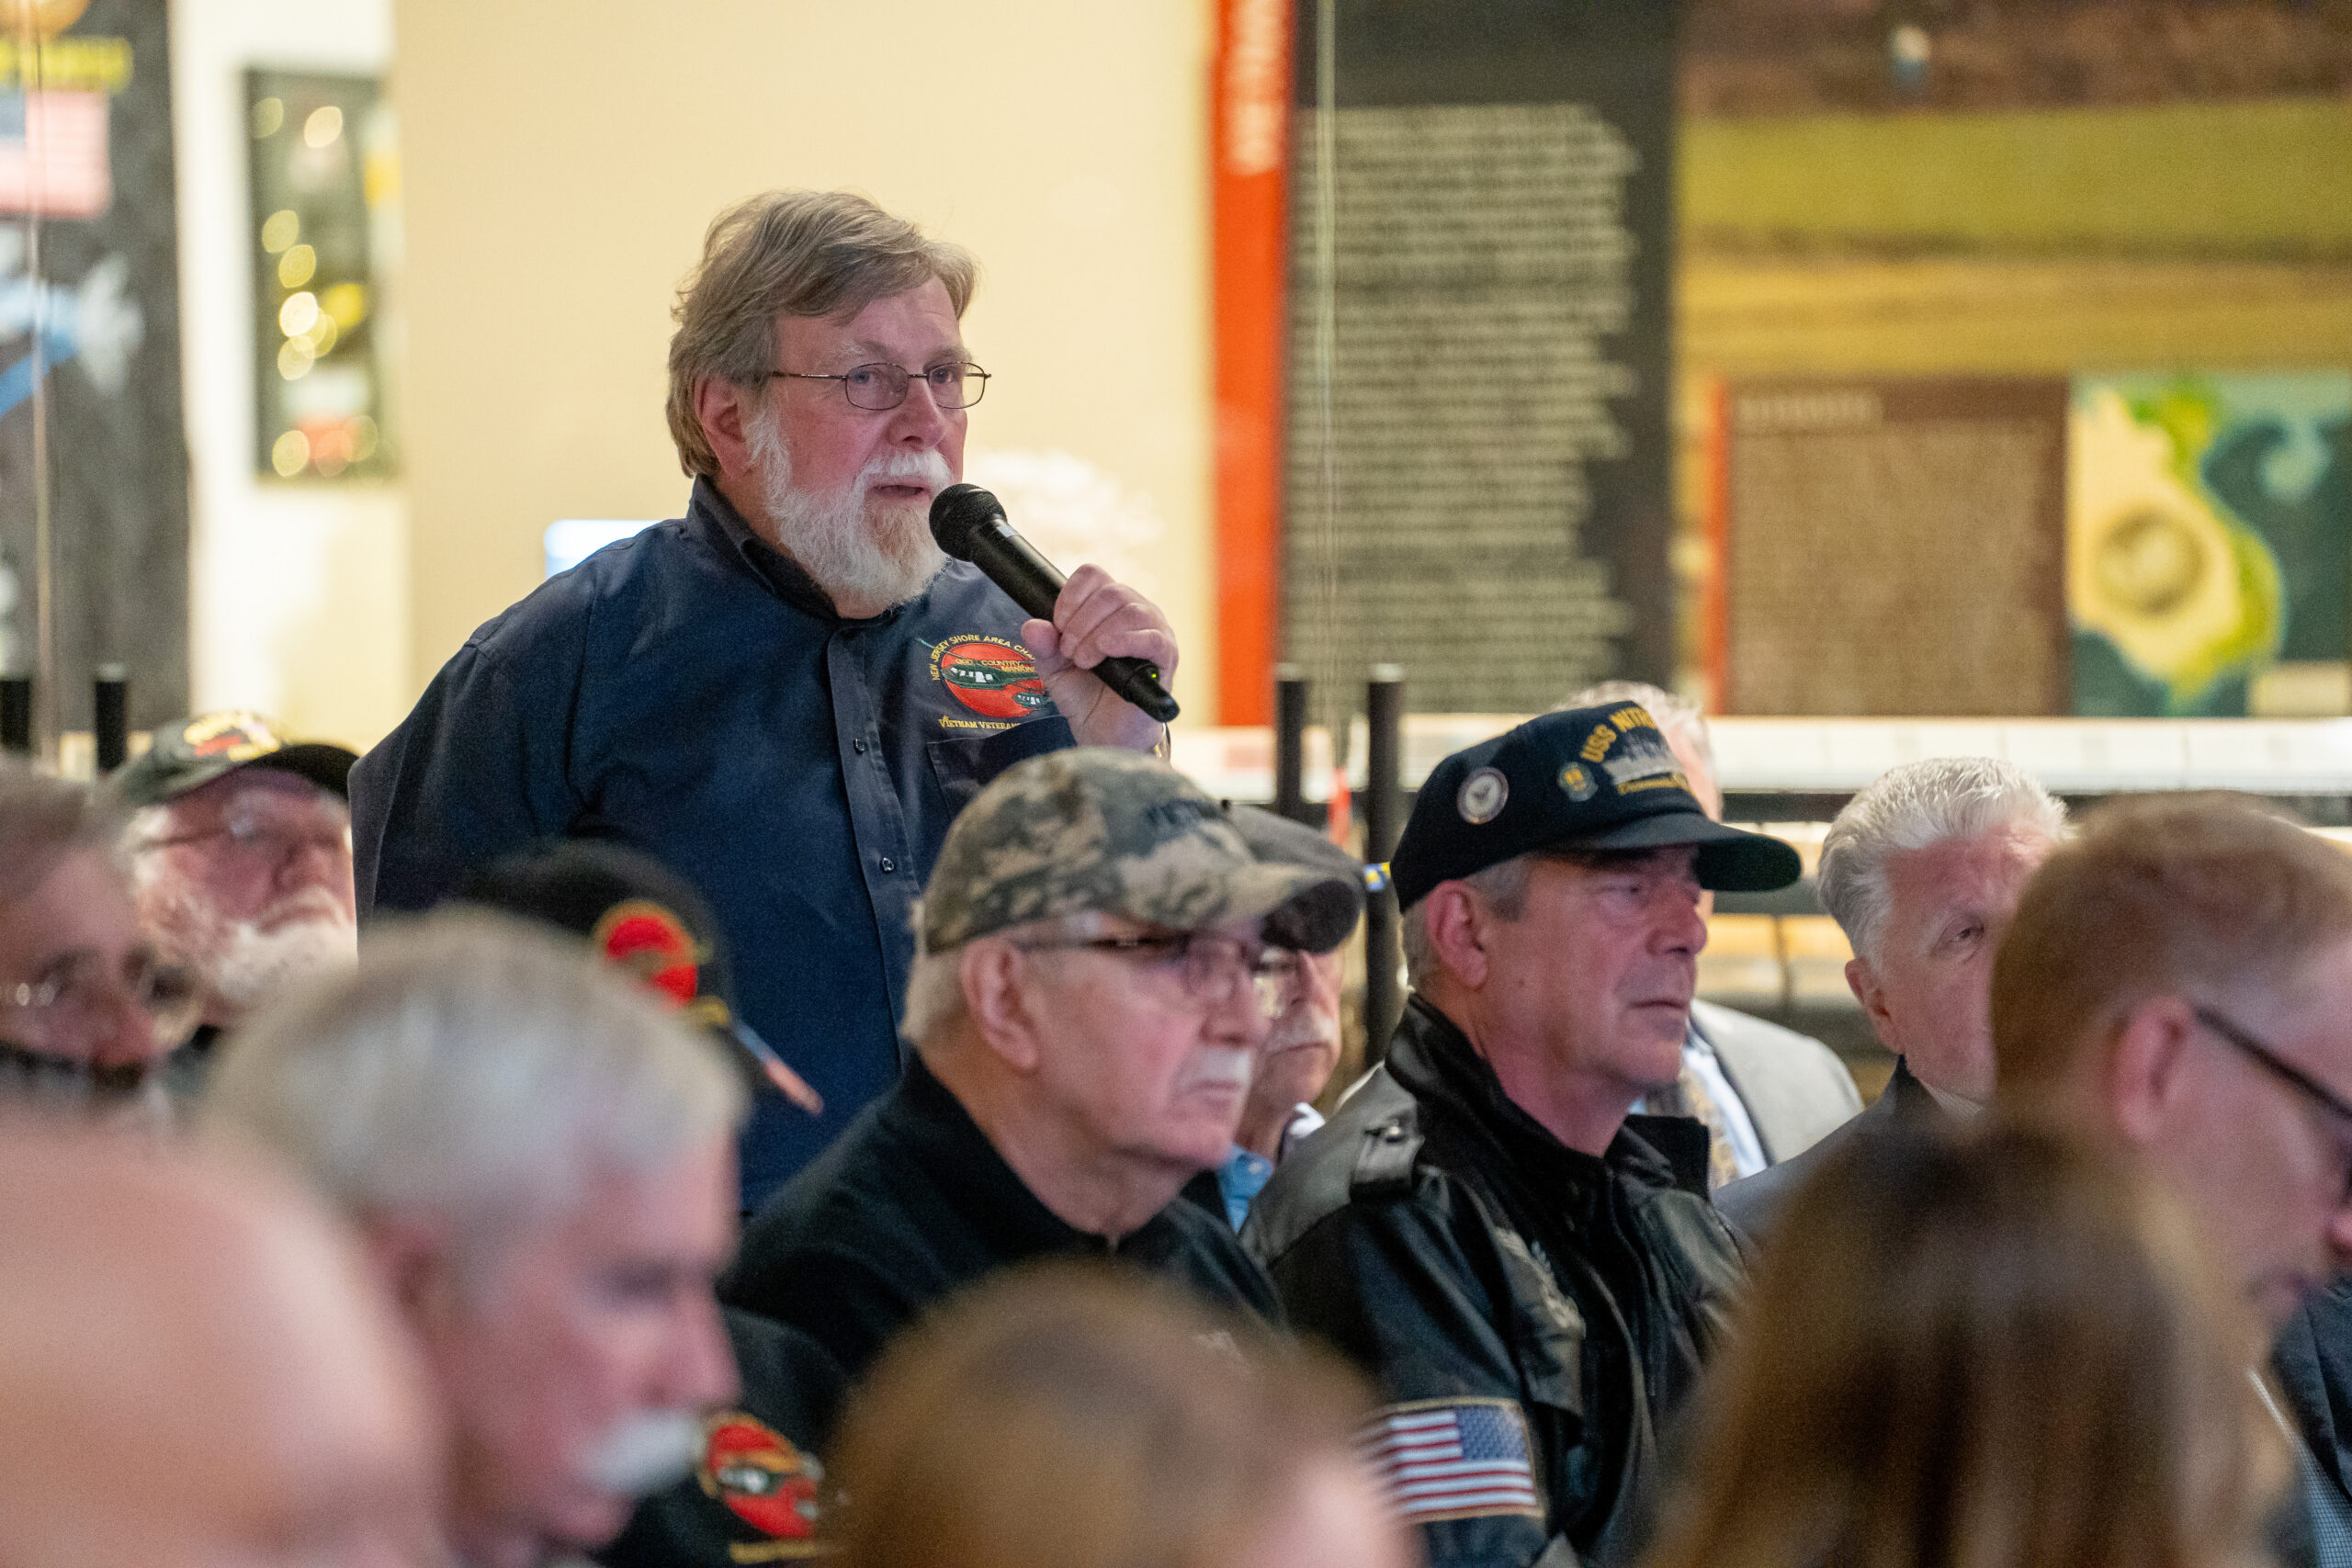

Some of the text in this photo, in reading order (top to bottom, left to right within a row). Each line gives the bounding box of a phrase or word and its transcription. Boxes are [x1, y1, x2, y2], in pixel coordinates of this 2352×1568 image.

[949, 635, 980, 644] SHORE
[983, 636, 1011, 648] AREA
[931, 639, 950, 663] JERSEY
[930, 663, 940, 680] NEW
[938, 715, 978, 728] VIETNAM
[1581, 724, 1617, 763] USS
